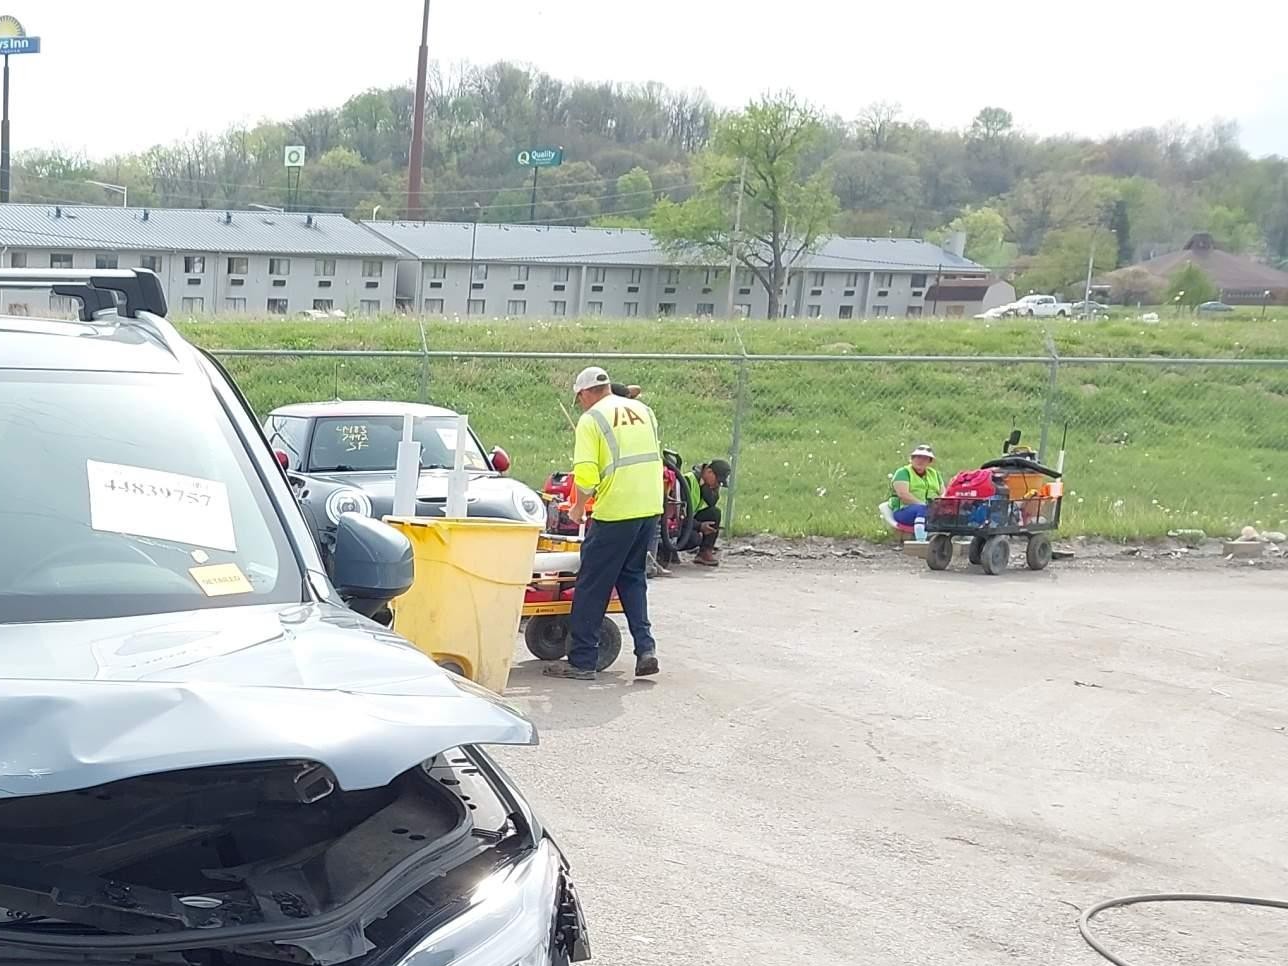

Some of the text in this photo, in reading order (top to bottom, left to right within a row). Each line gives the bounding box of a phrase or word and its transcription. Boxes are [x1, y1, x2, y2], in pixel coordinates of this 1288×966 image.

[10, 38, 29, 48] Inn
[517, 151, 530, 165] Q
[531, 150, 556, 160] Quality
